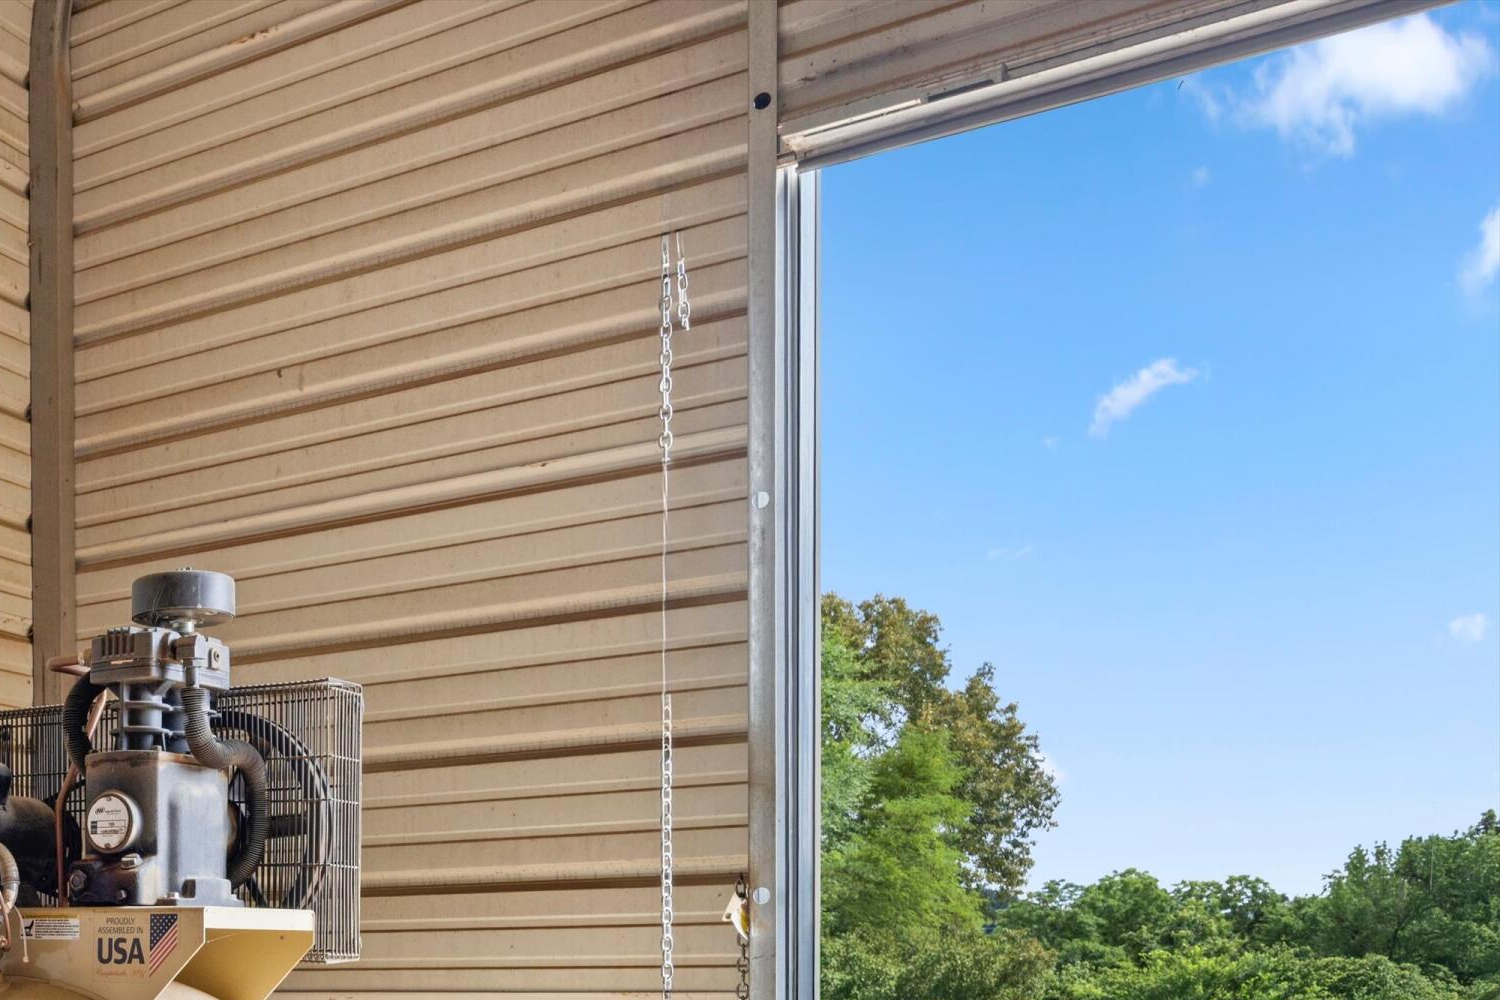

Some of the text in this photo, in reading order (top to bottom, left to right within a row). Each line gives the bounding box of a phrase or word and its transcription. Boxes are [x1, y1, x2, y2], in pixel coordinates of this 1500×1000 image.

[106, 917, 134, 925] PROUDLY
[97, 926, 135, 935] ASSEMBLED
[97, 937, 145, 965] USA
